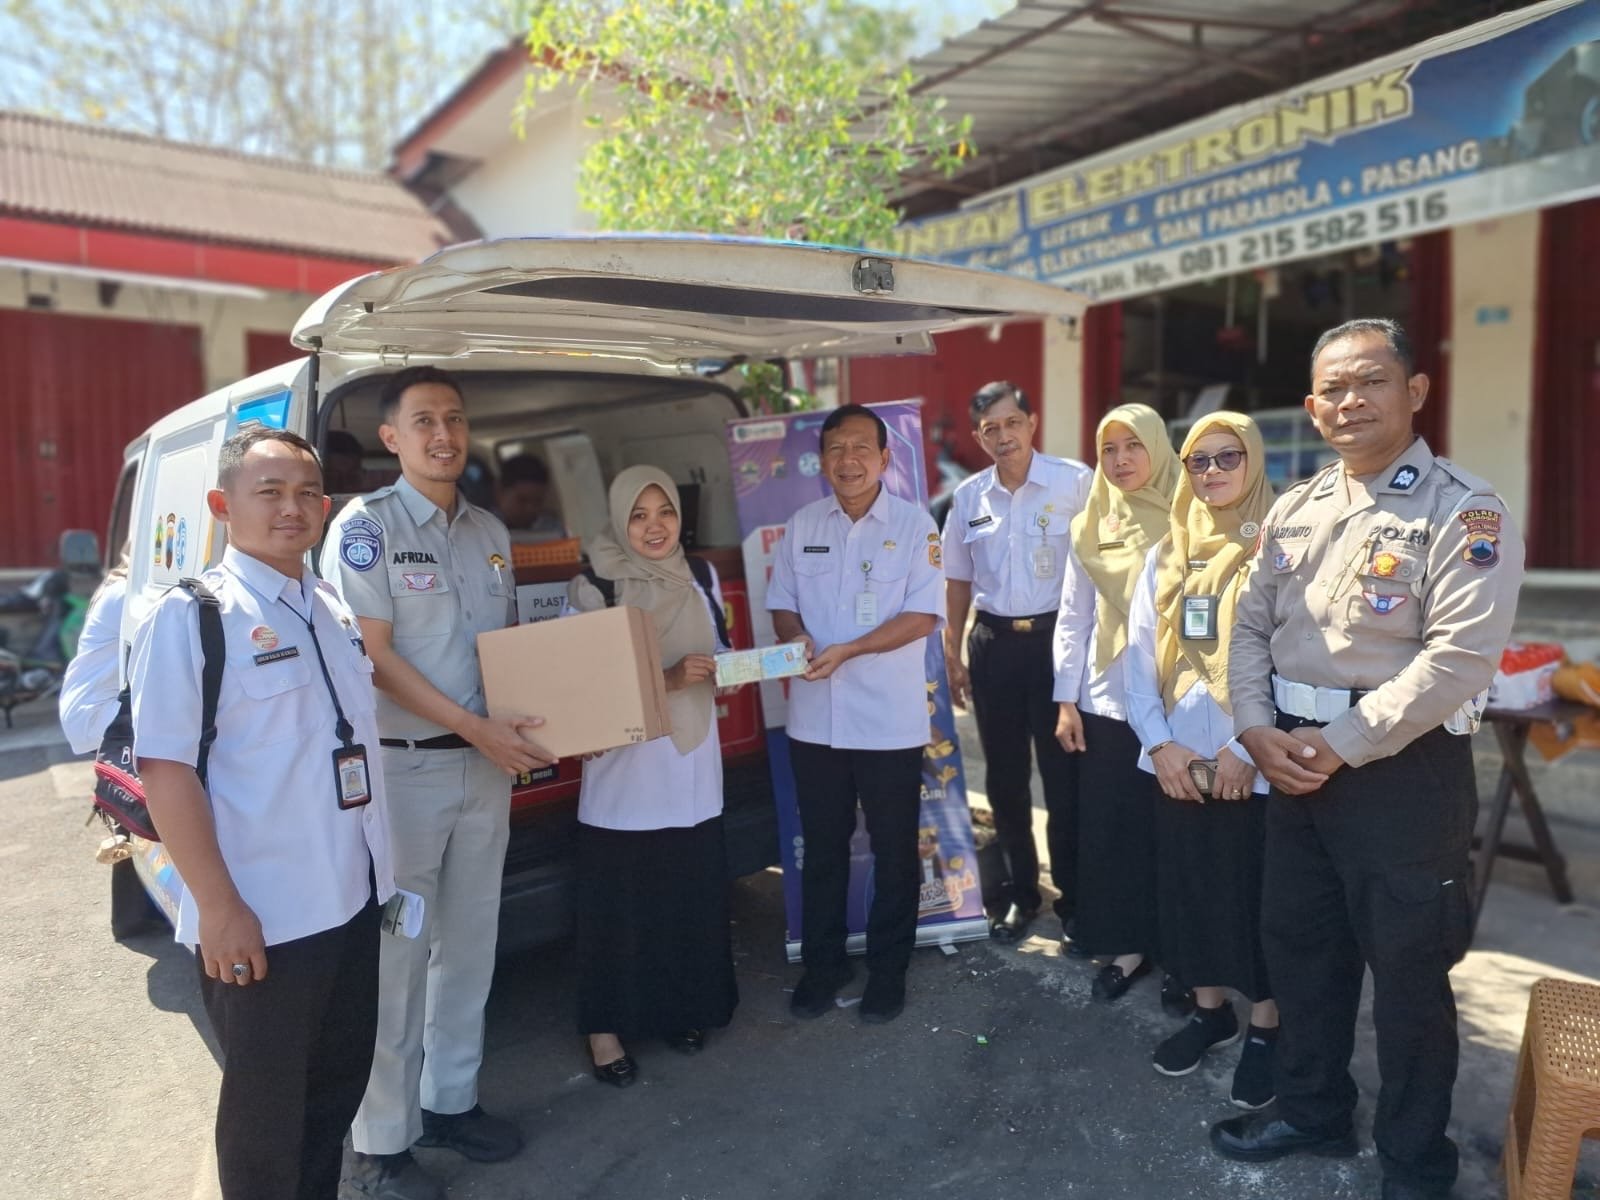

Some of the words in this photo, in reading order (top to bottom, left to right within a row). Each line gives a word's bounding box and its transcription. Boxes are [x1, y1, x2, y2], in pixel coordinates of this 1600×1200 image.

[1029, 66, 1408, 227] ELEKTRONIK
[1154, 157, 1301, 218] ELEKTRONIK
[1158, 214, 1203, 246] DAN
[1207, 179, 1332, 231] PARABOLA
[1361, 139, 1480, 195] PASANG
[1180, 242, 1229, 275] 081
[1240, 226, 1297, 264] 215
[1305, 209, 1367, 251] 582
[1377, 189, 1448, 233] 516
[1461, 510, 1499, 520] POLRES
[1369, 525, 1430, 546] POLRI
[393, 551, 438, 564] AFRIZAL
[533, 595, 566, 608] PLAST
[919, 788, 947, 801] GIRI
